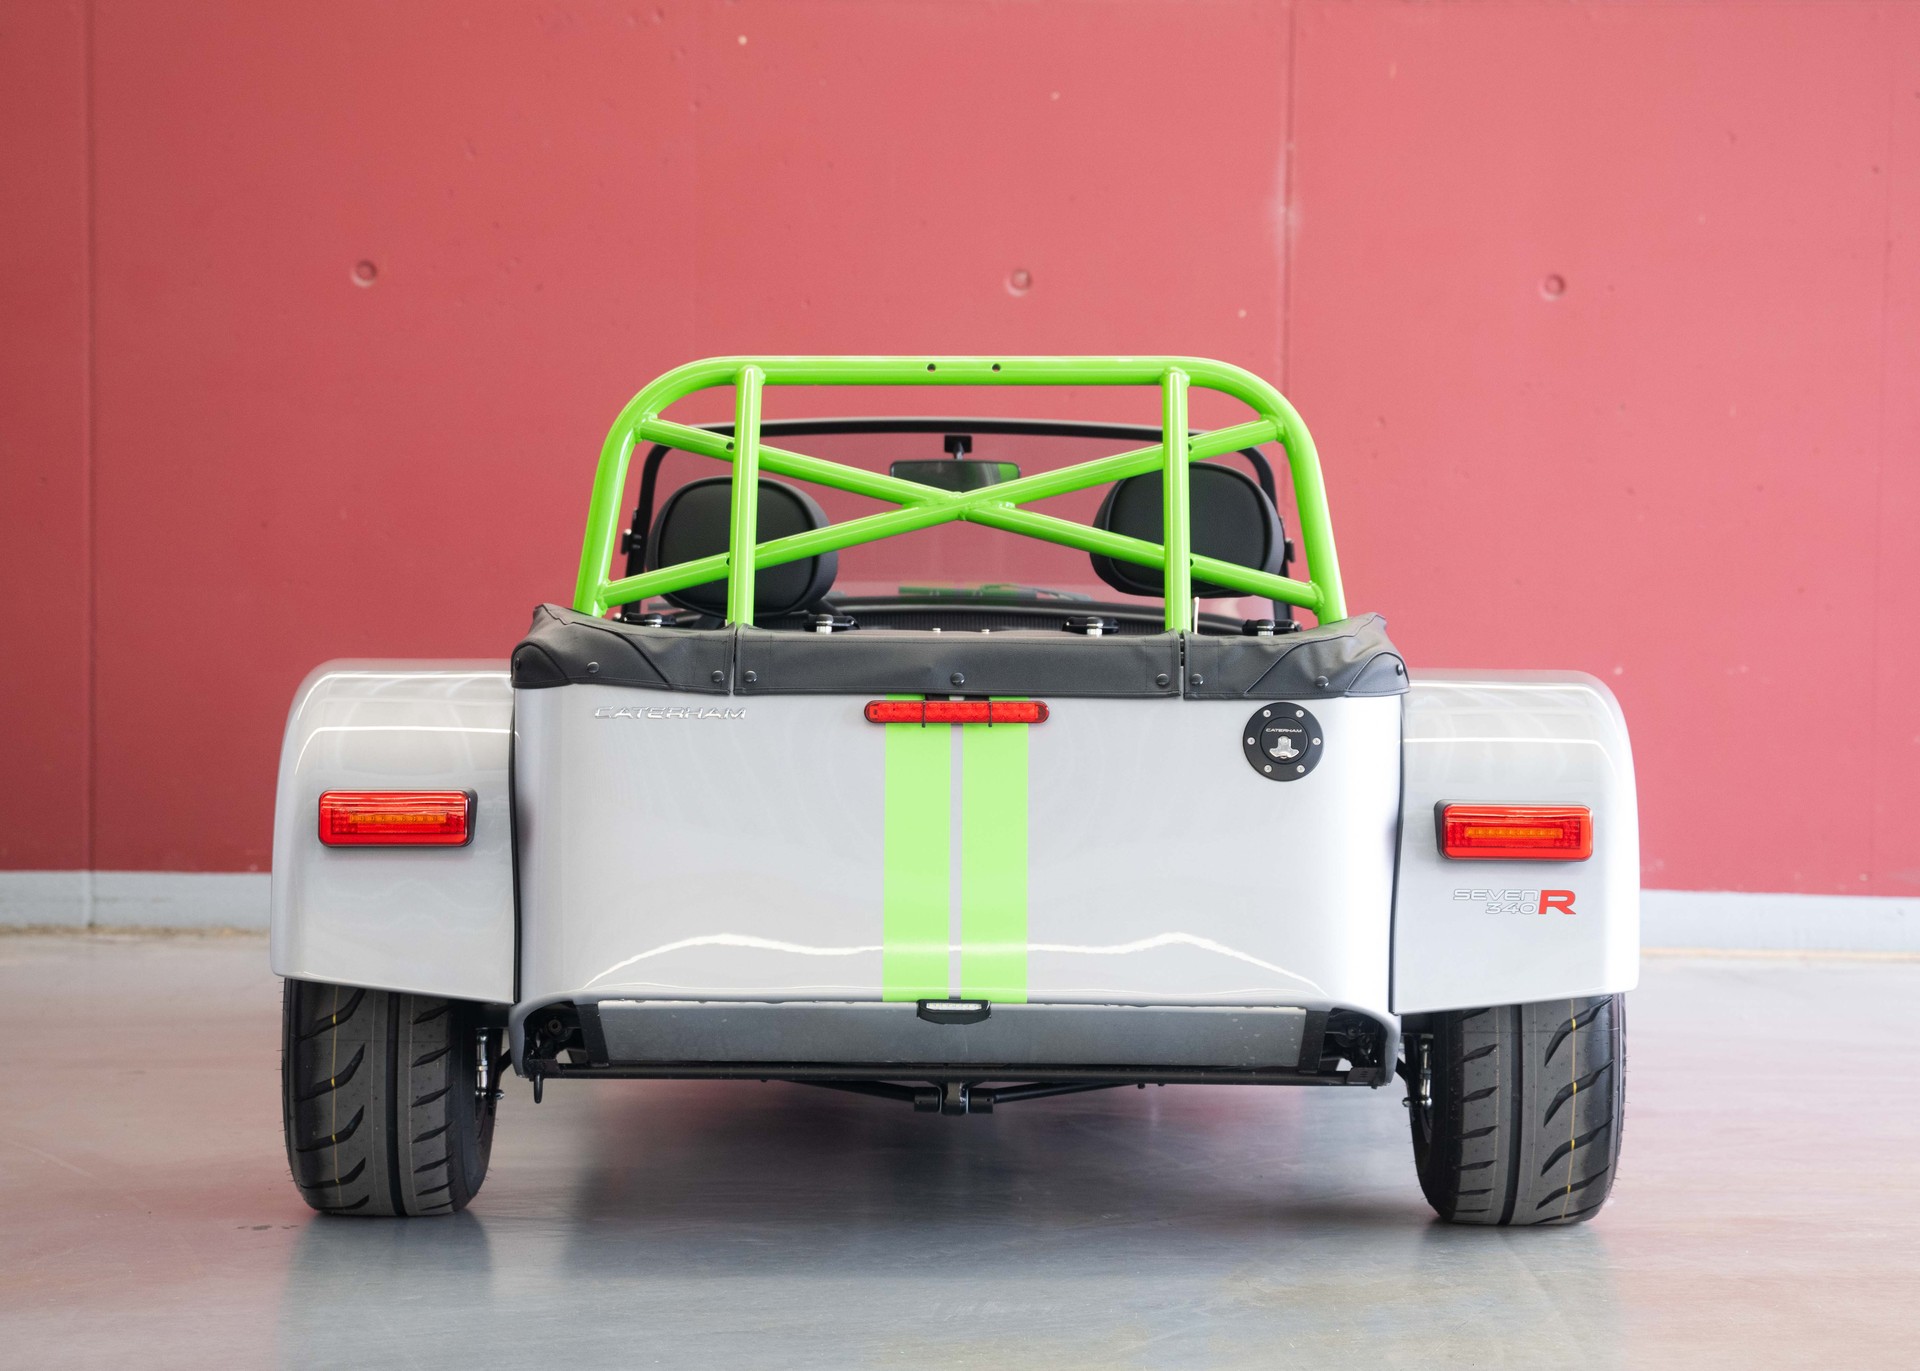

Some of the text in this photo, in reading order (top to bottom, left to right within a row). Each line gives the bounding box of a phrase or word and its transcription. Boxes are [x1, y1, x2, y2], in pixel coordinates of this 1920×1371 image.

[594, 705, 747, 719] CATERHAM
[1485, 889, 1577, 915] 340 R
